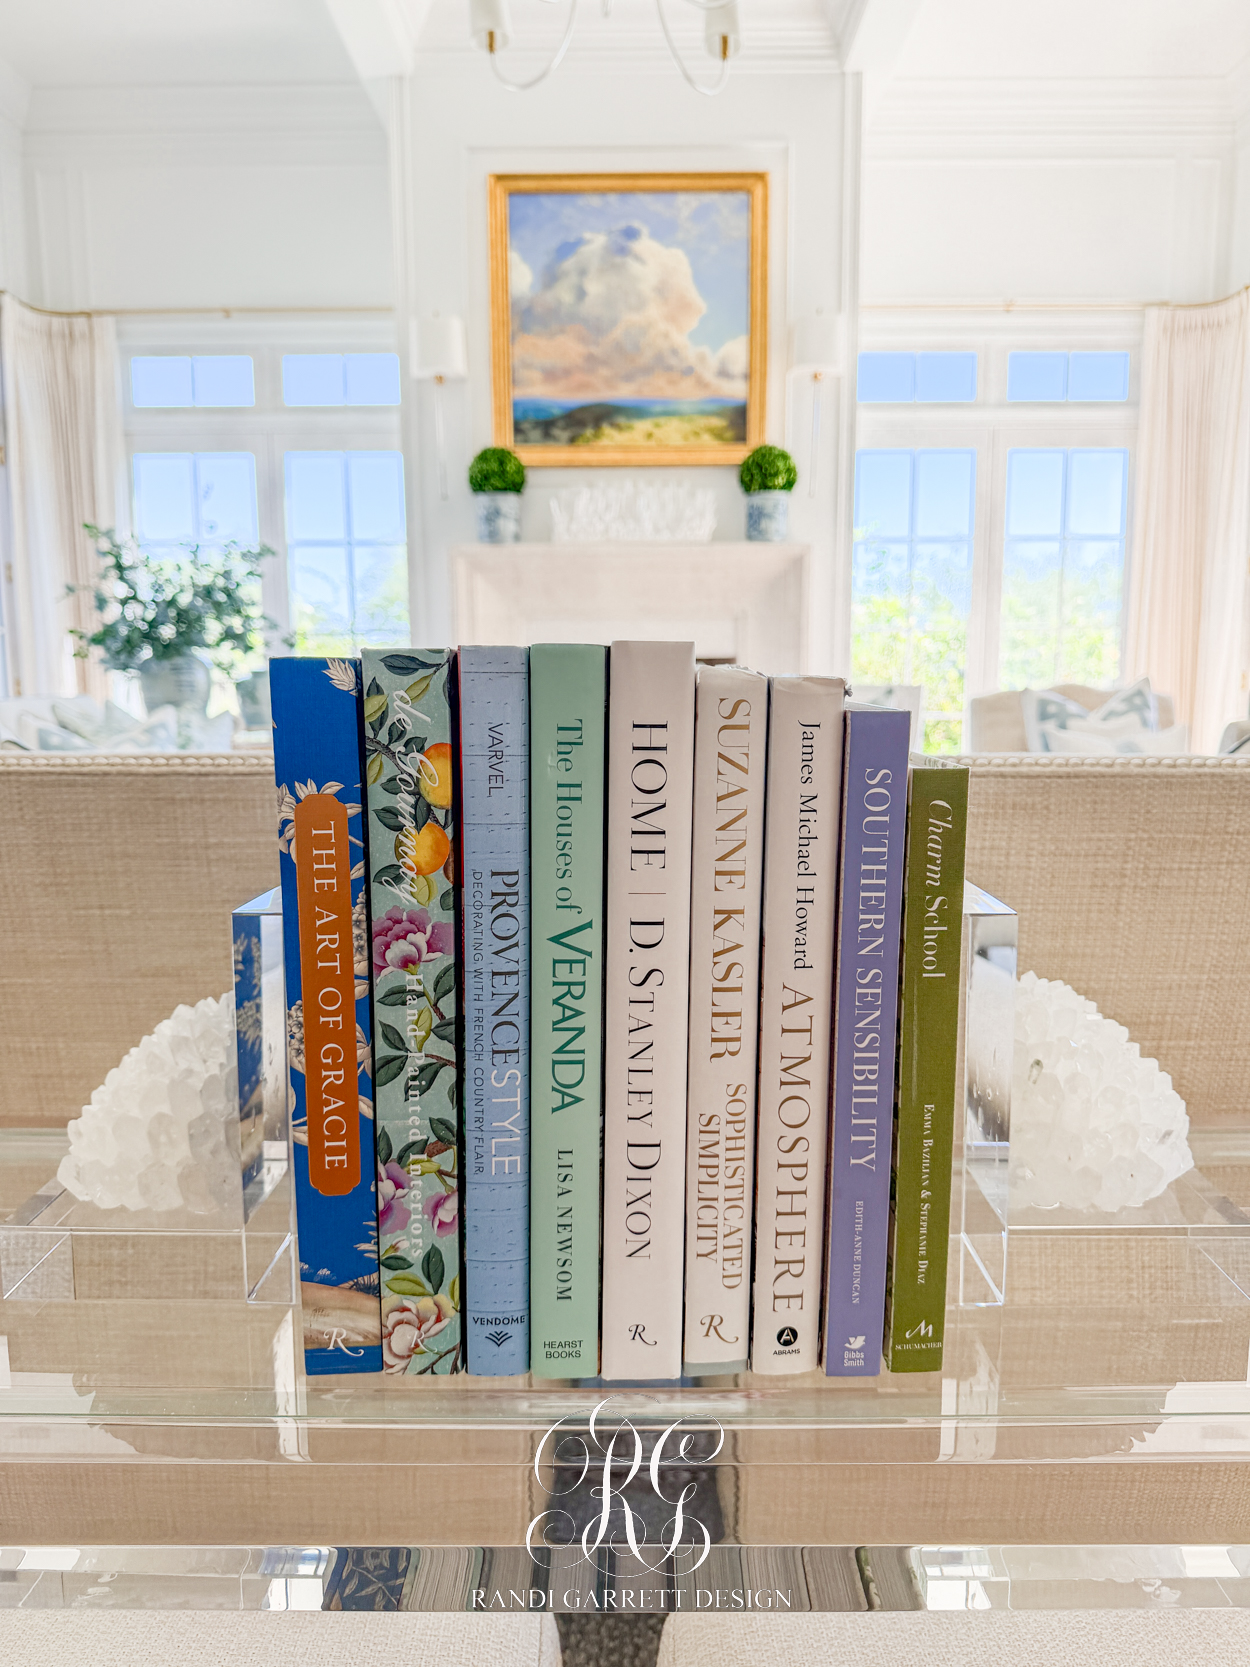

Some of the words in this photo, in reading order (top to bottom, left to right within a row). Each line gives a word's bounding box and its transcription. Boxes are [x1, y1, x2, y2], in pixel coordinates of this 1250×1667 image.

[392, 690, 432, 732] de
[488, 723, 504, 796] VARVEL
[556, 718, 584, 772] The
[797, 719, 821, 785] James
[381, 743, 439, 905] Gournay
[630, 720, 668, 871] HOME
[714, 697, 751, 892] SUZANNE
[311, 820, 338, 894] THE
[556, 781, 583, 879] Houses
[797, 793, 819, 877] Michael
[857, 768, 893, 958] SOUTHERN
[925, 799, 953, 887] Charm
[472, 870, 484, 963] DECORATING
[556, 886, 583, 915] of
[793, 886, 815, 970] Howard
[315, 906, 342, 975] ART
[629, 917, 665, 953] D.
[922, 895, 948, 978] School
[318, 987, 343, 1030] OF
[473, 967, 484, 1002] WITH
[546, 918, 594, 1114] VERANDA
[709, 905, 745, 1064] KASLER
[405, 973, 429, 1140] Hand-Painted
[473, 1008, 485, 1061] FRENCH
[627, 966, 665, 1128] STANLEY
[473, 1067, 485, 1132] COUNTRY
[850, 968, 883, 1172] SENSIBILITY
[320, 1043, 348, 1170] GRACIE
[474, 1136, 485, 1173] FLAIR
[556, 1148, 574, 1198] LISA
[772, 982, 815, 1312] ATMOSPHERE
[409, 1152, 429, 1258] Interiors
[625, 1139, 661, 1259] DIXON
[696, 1112, 721, 1264] SIMPLICITY
[721, 1083, 747, 1290] SOPHISTICATED
[920, 1189, 932, 1200] &
[556, 1205, 573, 1302] NEWSOM
[853, 1200, 864, 1261] EDITH-ANNE
[851, 1263, 862, 1304] DUNCAN
[323, 1327, 365, 1357] R
[472, 1314, 526, 1327] VENDOME
[543, 1339, 584, 1349] HEARST
[545, 1349, 582, 1359] BOOKS
[628, 1323, 658, 1346] R
[700, 1313, 739, 1344] R
[772, 1348, 801, 1356] ABRAMS
[779, 1327, 796, 1344] A
[894, 1341, 943, 1350] SCHUMACHER
[843, 1350, 865, 1359] Gibbs
[843, 1358, 865, 1367] Smith
